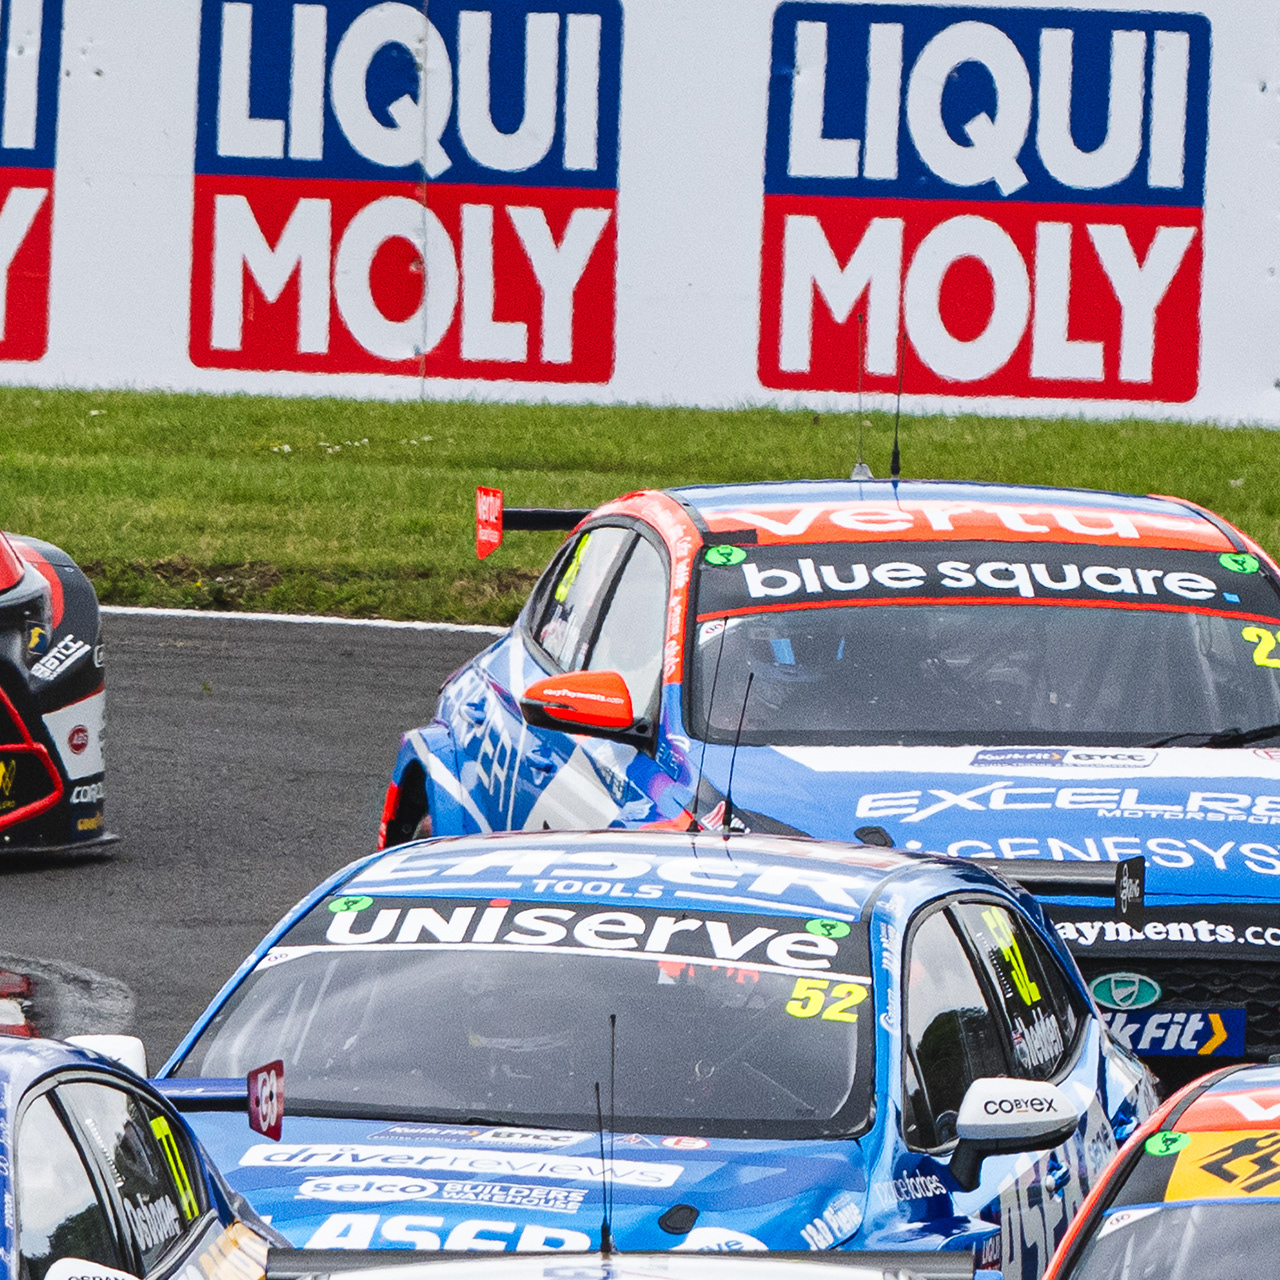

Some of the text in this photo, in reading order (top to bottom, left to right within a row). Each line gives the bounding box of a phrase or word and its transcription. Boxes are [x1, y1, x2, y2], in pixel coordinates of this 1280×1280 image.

[217, 2, 601, 179] LIQUI
[787, 20, 1189, 196] LIQUI
[210, 195, 611, 363] MOLY
[778, 214, 1198, 383] MOLY
[531, 877, 663, 900] TOOLS
[785, 977, 869, 1021] 52
[1108, 1013, 1209, 1053] kFit
[310, 1178, 427, 1195] selco
[441, 1191, 581, 1210] WAREHOUSE
[443, 1181, 587, 1202] BUILDERS
[303, 1212, 592, 1251] ASER
